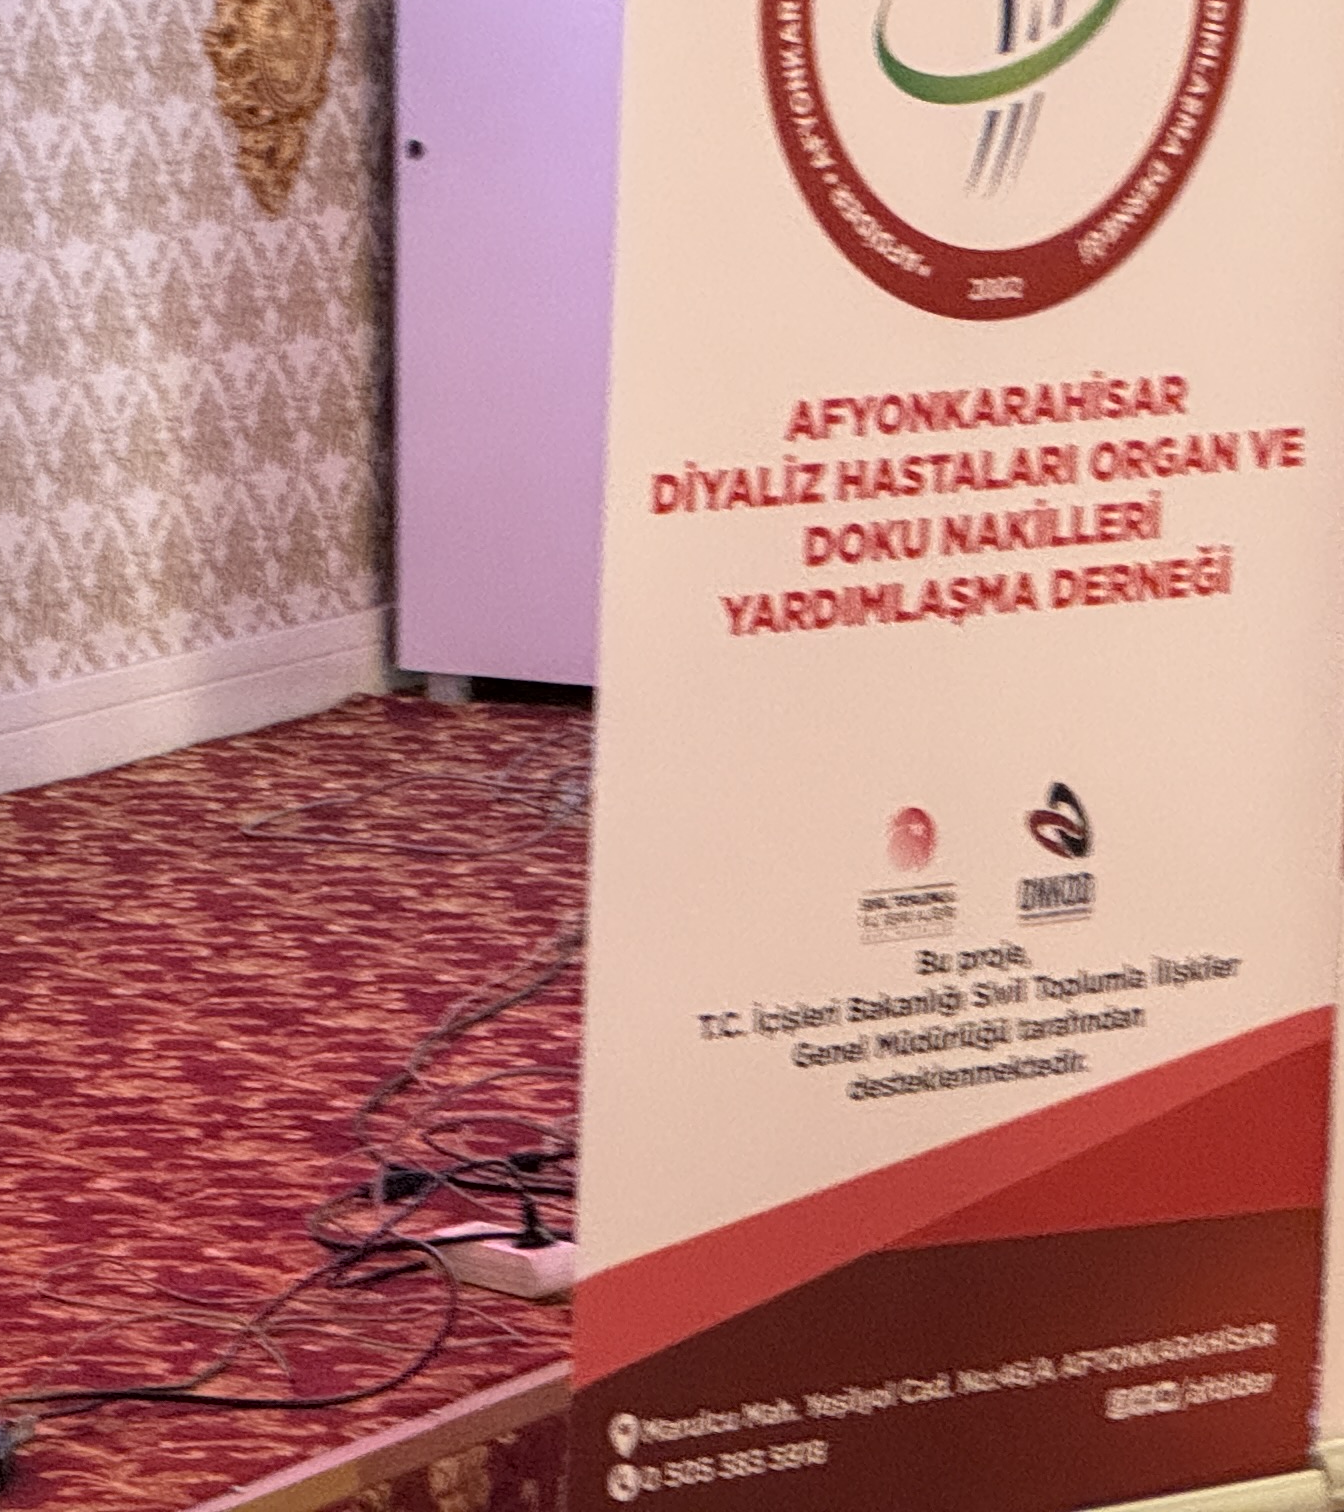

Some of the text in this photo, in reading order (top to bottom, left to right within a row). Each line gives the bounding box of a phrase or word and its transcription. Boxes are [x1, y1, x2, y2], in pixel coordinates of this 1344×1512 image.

[783, 370, 1189, 442] AFYONKARAHİSAR
[651, 426, 1307, 515] DİYALİZ HASTALARI ORGAN VE
[803, 489, 1164, 567] DOKU NAKİLLERİ
[719, 544, 1234, 637] YARDIMLAŞMA DERNEĞİ
